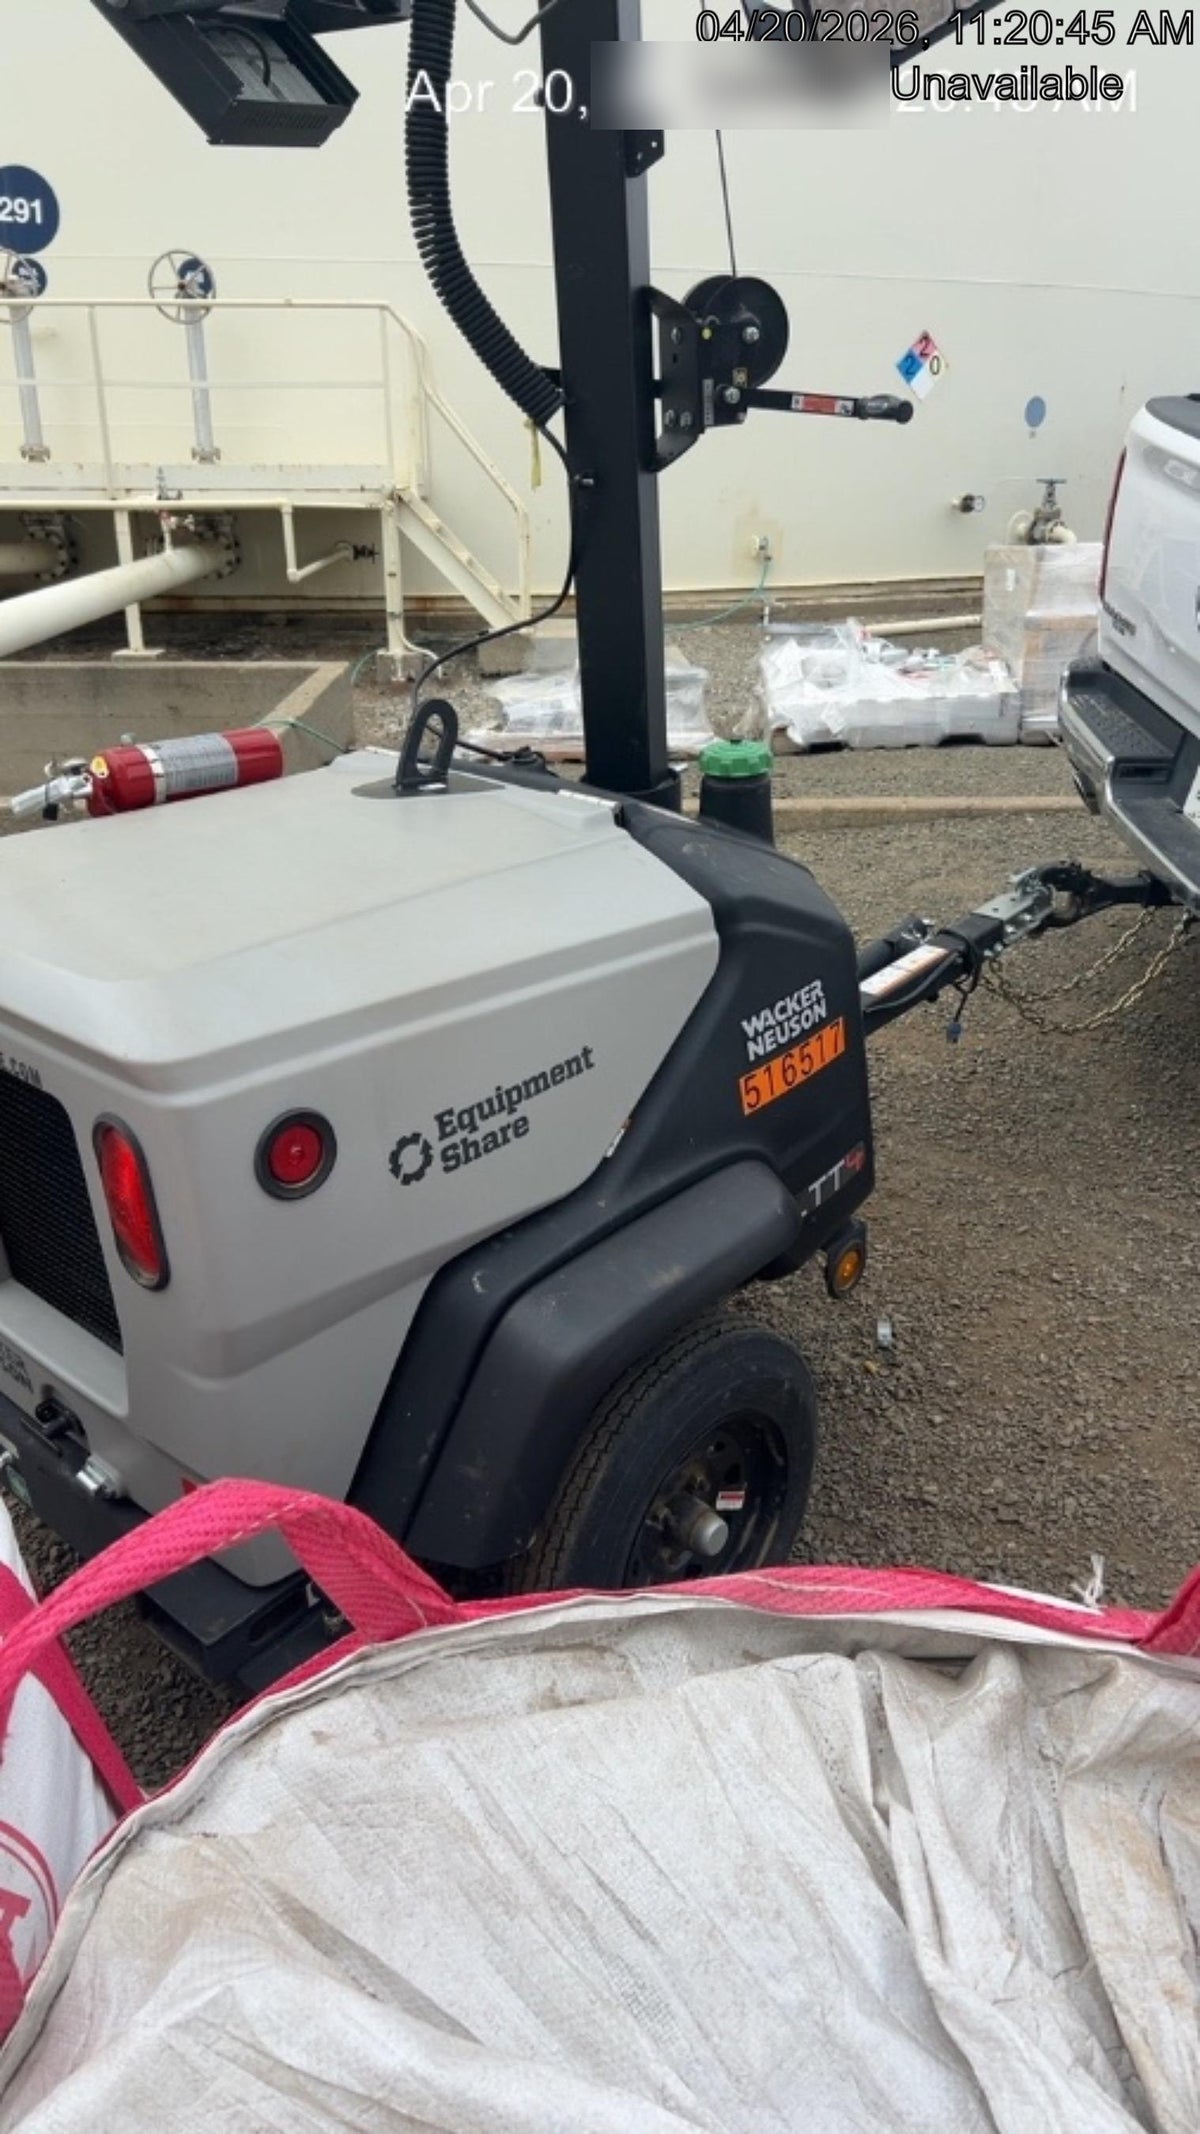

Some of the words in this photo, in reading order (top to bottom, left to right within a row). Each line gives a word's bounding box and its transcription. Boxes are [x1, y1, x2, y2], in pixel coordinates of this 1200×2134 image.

[929, 354, 940, 376] 0
[741, 979, 824, 1039] WACKER
[746, 998, 827, 1062] NEUSON
[434, 1045, 595, 1142] Equipment
[743, 1021, 841, 1109] 516517
[439, 1115, 530, 1175] Share
